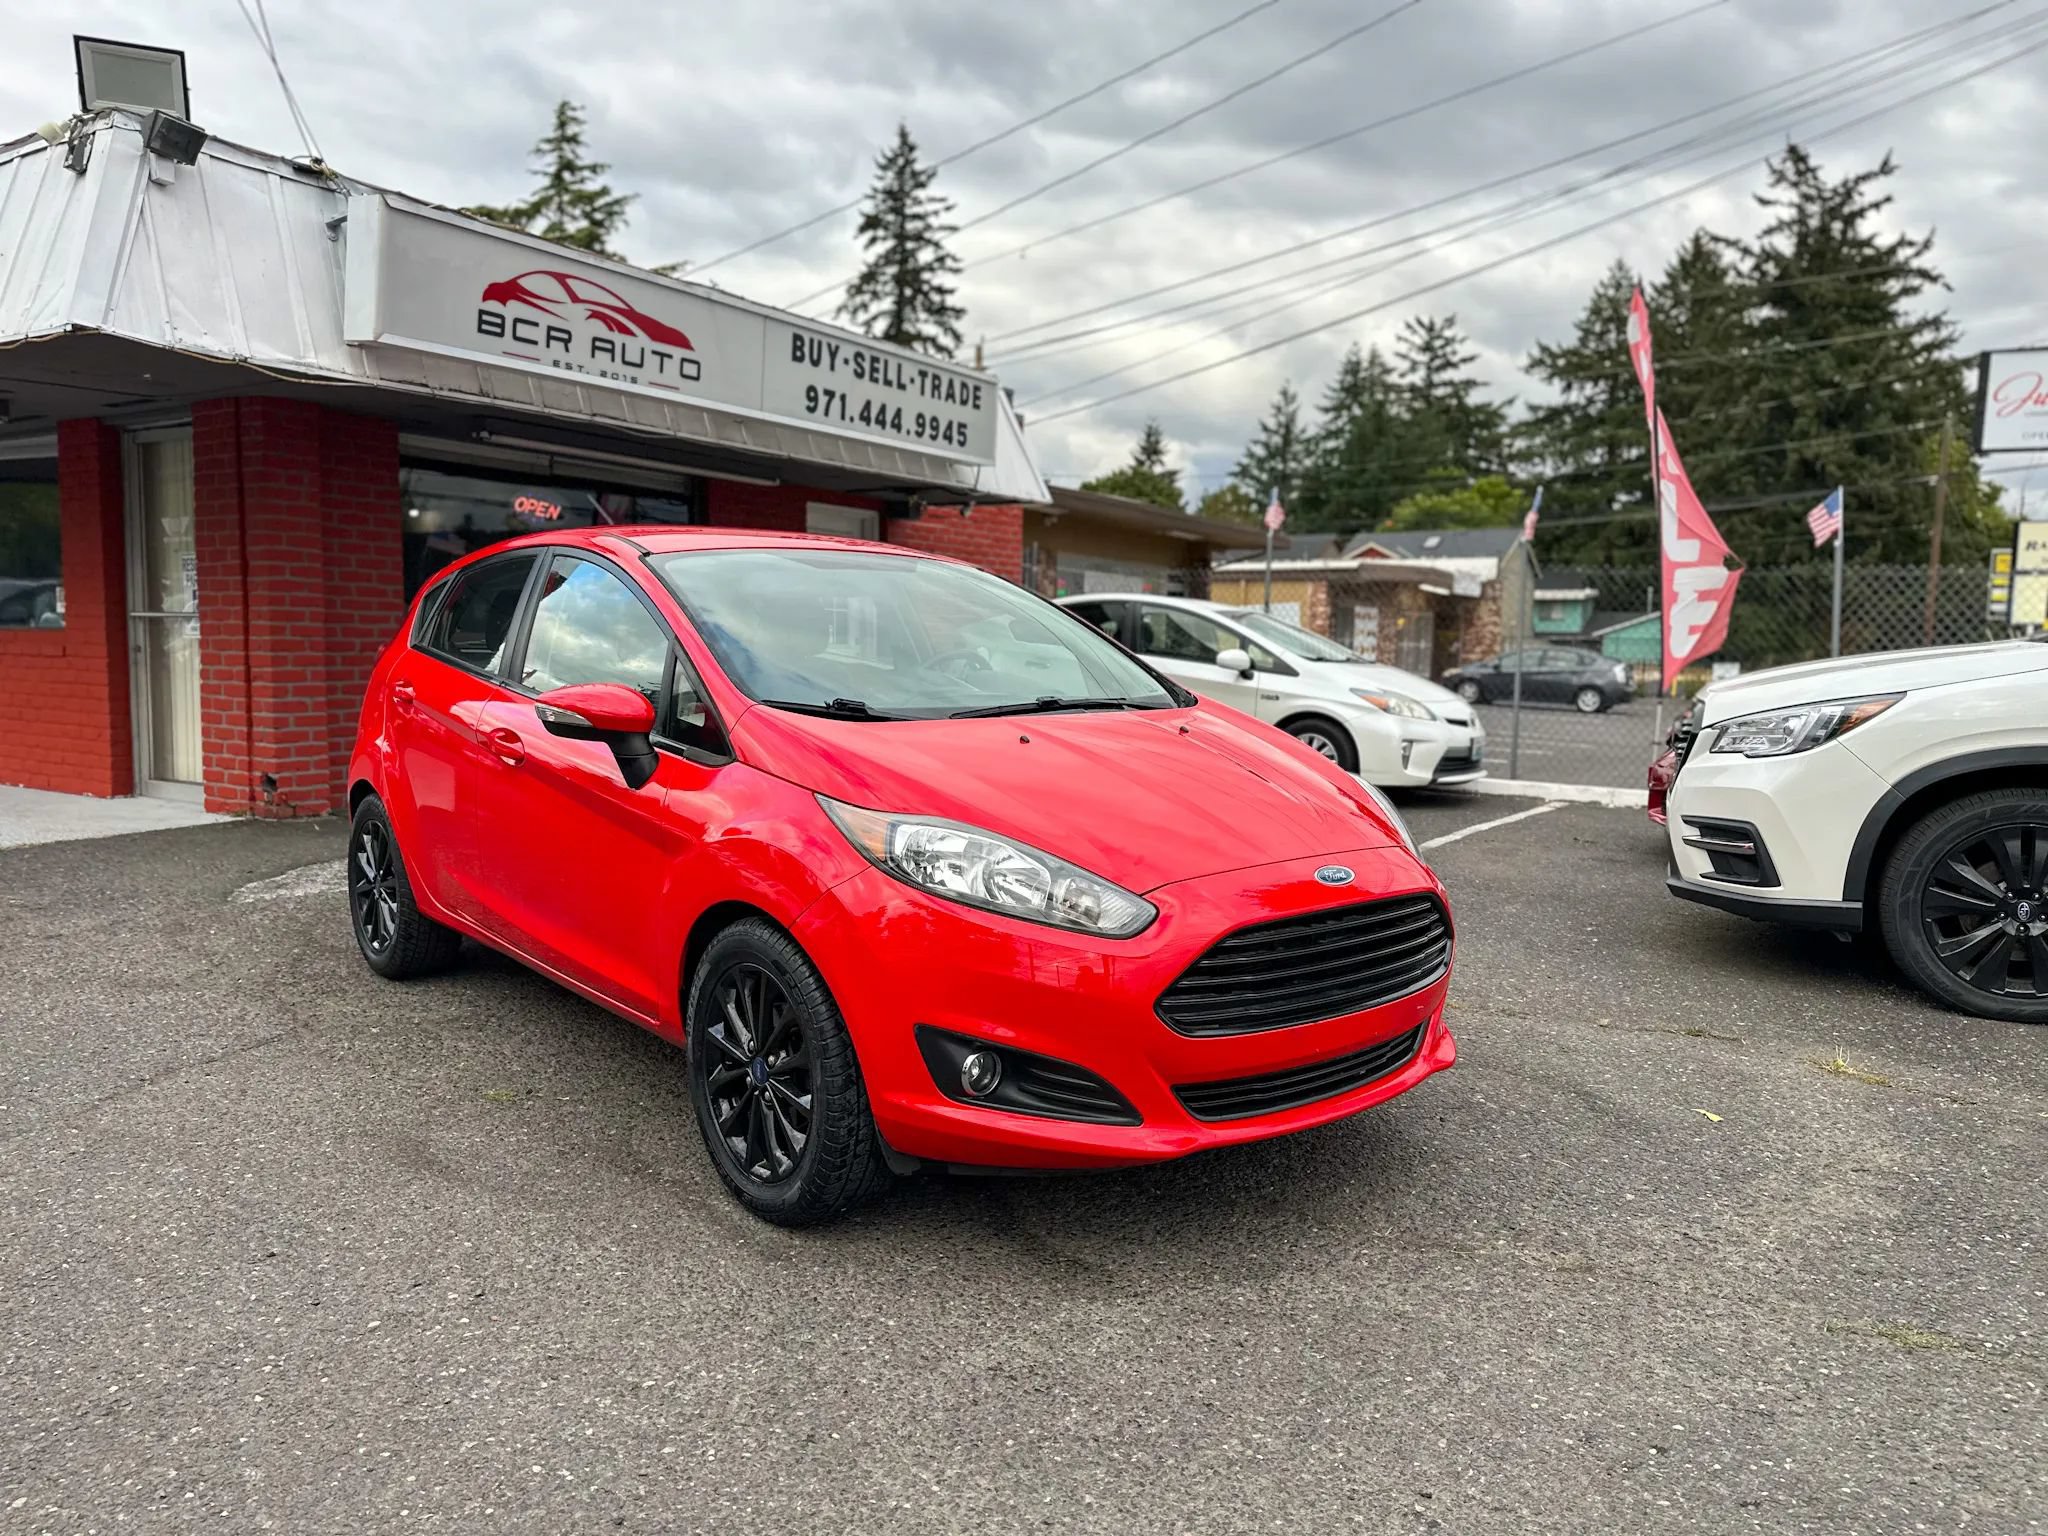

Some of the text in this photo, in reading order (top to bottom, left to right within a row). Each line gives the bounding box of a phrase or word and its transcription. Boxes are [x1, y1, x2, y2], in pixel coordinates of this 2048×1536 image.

[477, 308, 701, 382] BCR AUTO
[805, 384, 968, 448] 971.444.9945
[514, 496, 562, 520] OPEN
